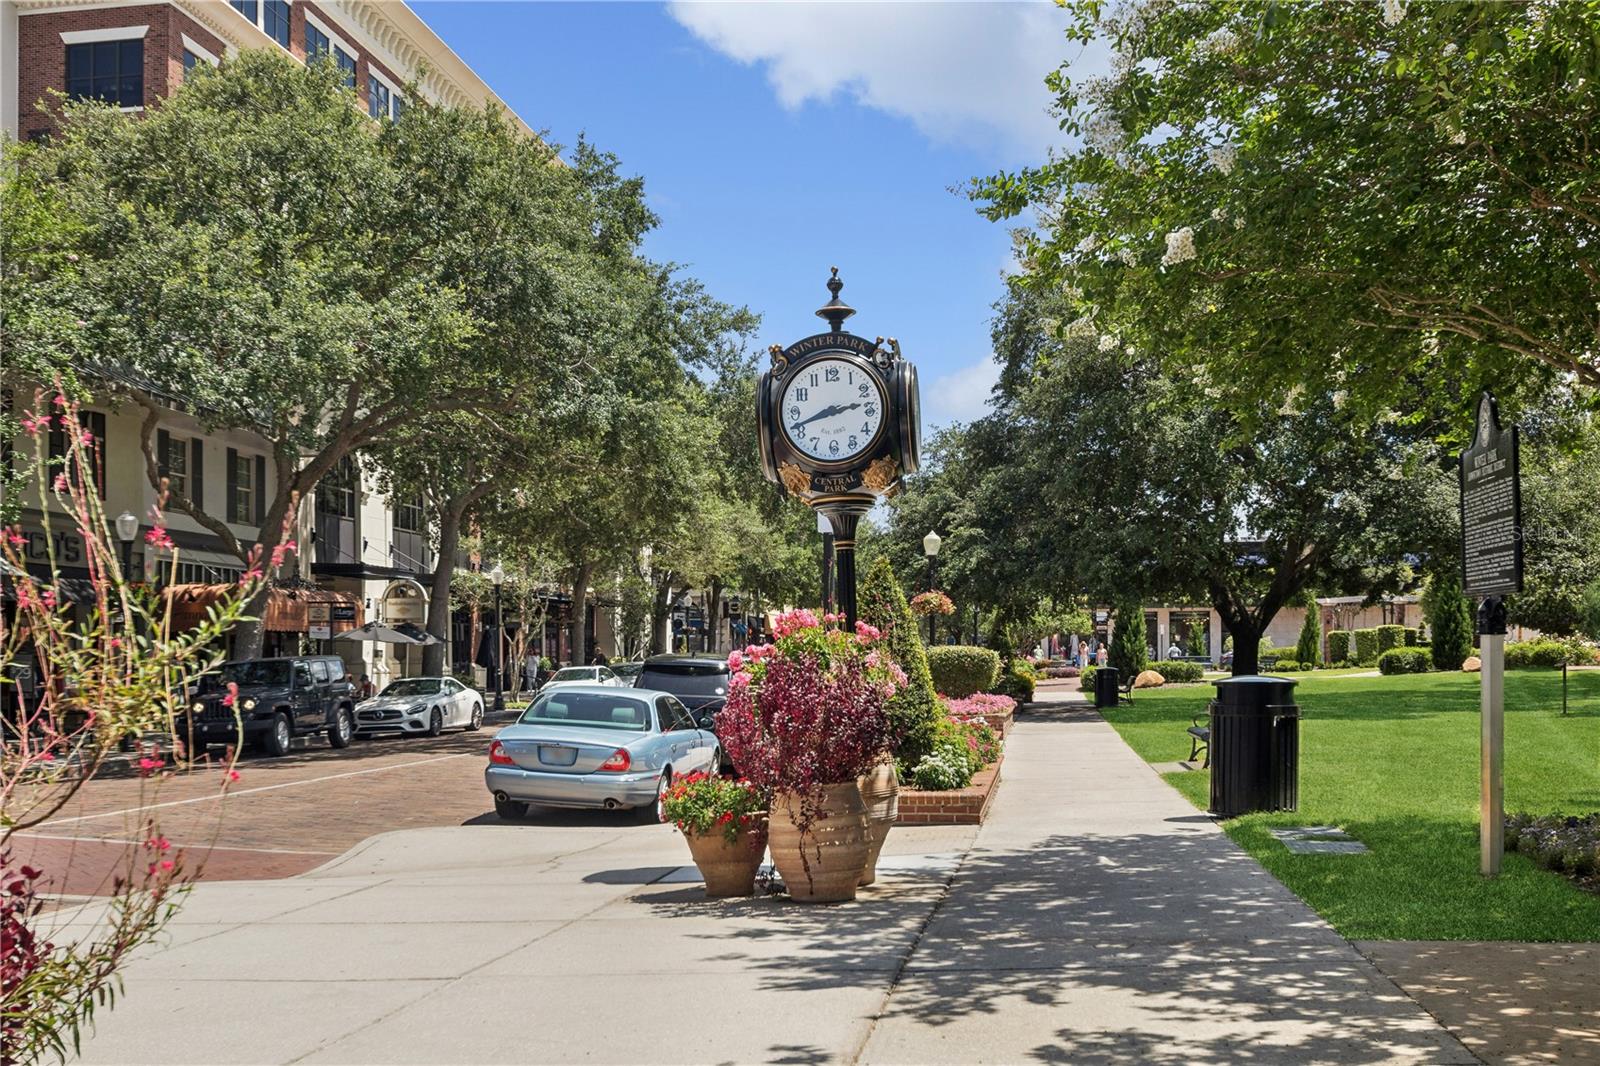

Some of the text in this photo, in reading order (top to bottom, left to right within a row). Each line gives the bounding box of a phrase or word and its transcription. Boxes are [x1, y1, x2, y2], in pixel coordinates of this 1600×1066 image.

[789, 335, 867, 356] WINTER PARK
[810, 374, 819, 387] 11
[825, 368, 840, 382] 12
[849, 371, 853, 385] 1
[796, 388, 808, 401] 10
[859, 384, 870, 398] 2
[791, 406, 800, 420] 9
[864, 402, 875, 417] 3
[797, 423, 806, 439] 8
[860, 421, 871, 435] 4
[810, 437, 820, 451] 7
[829, 440, 839, 455] 6
[848, 435, 858, 449] 5
[814, 474, 857, 487] CENTRAL
[824, 485, 848, 493] PARK
